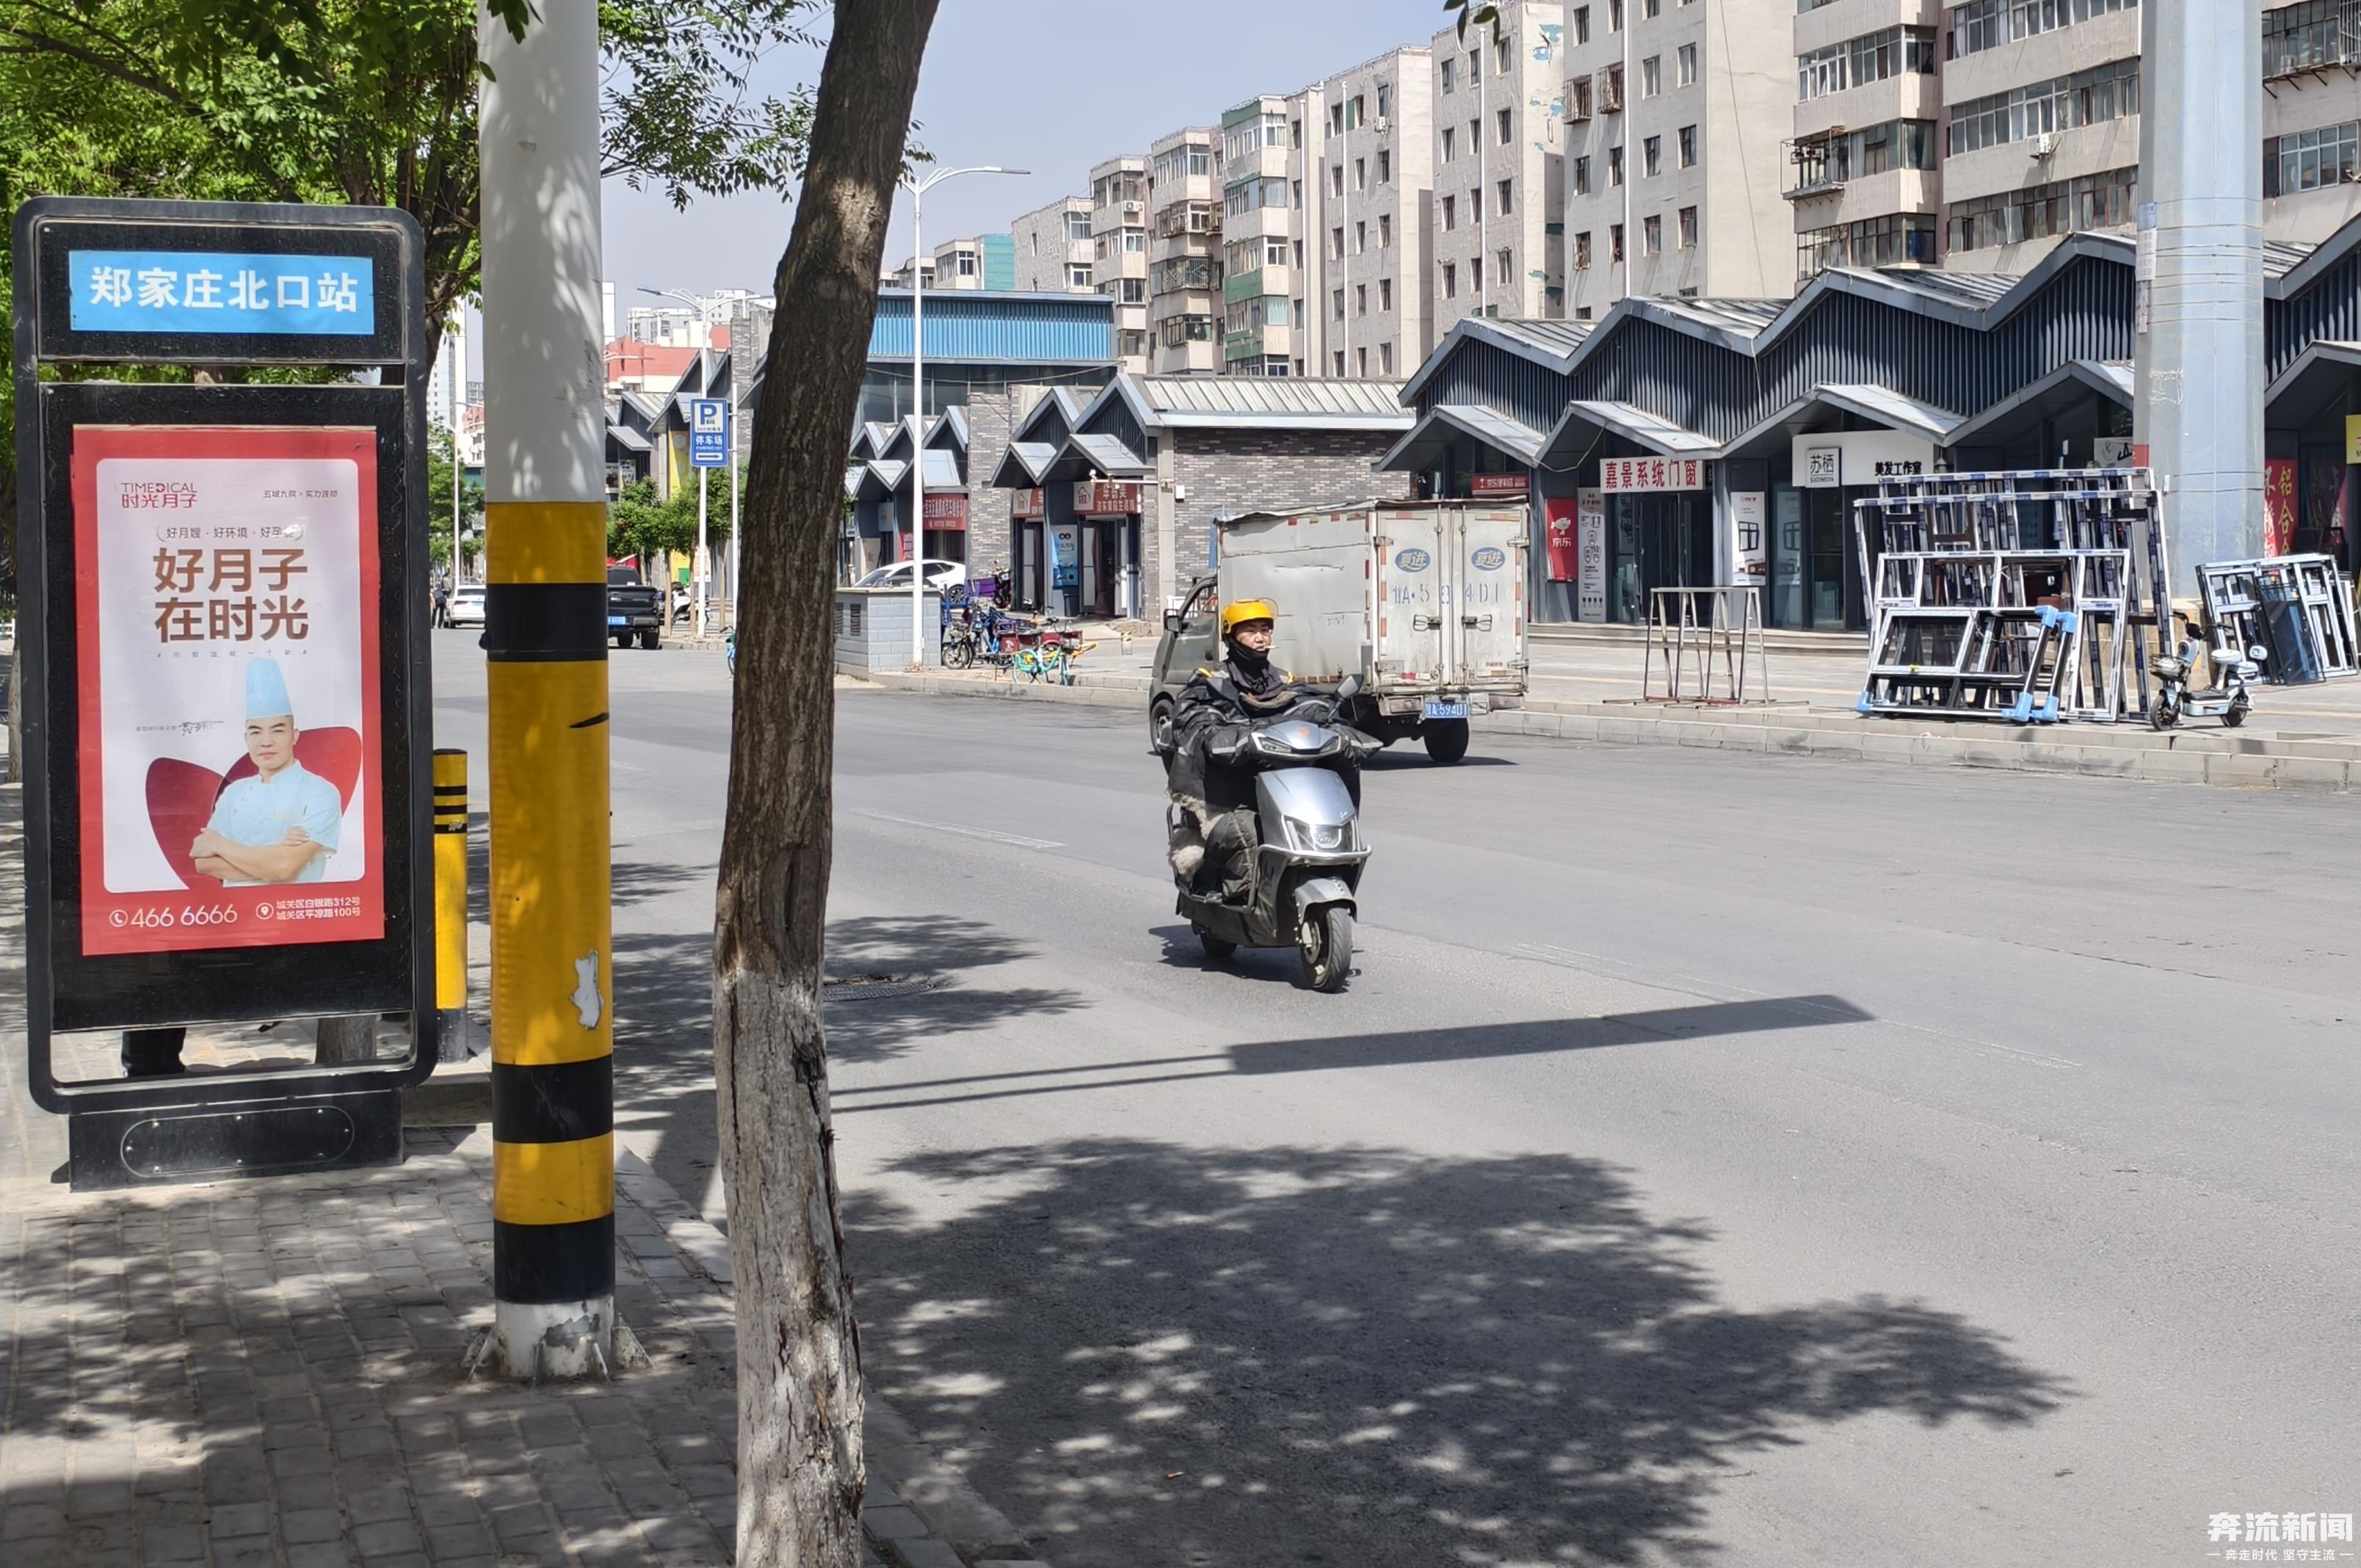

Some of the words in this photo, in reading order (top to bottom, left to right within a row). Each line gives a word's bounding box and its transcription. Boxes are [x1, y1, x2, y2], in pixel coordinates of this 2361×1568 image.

[90, 266, 358, 313] 郑家庄北口站
[700, 404, 717, 424] P
[1606, 460, 1697, 489] 嘉景系统门窗
[1810, 454, 1835, 474] 苏栖
[1875, 461, 1922, 476] 美发工作室
[122, 493, 197, 508] 时光月子
[153, 548, 308, 593] 好月子
[154, 595, 309, 643] 在时光
[131, 907, 174, 928] 466
[181, 904, 238, 926] 6666
